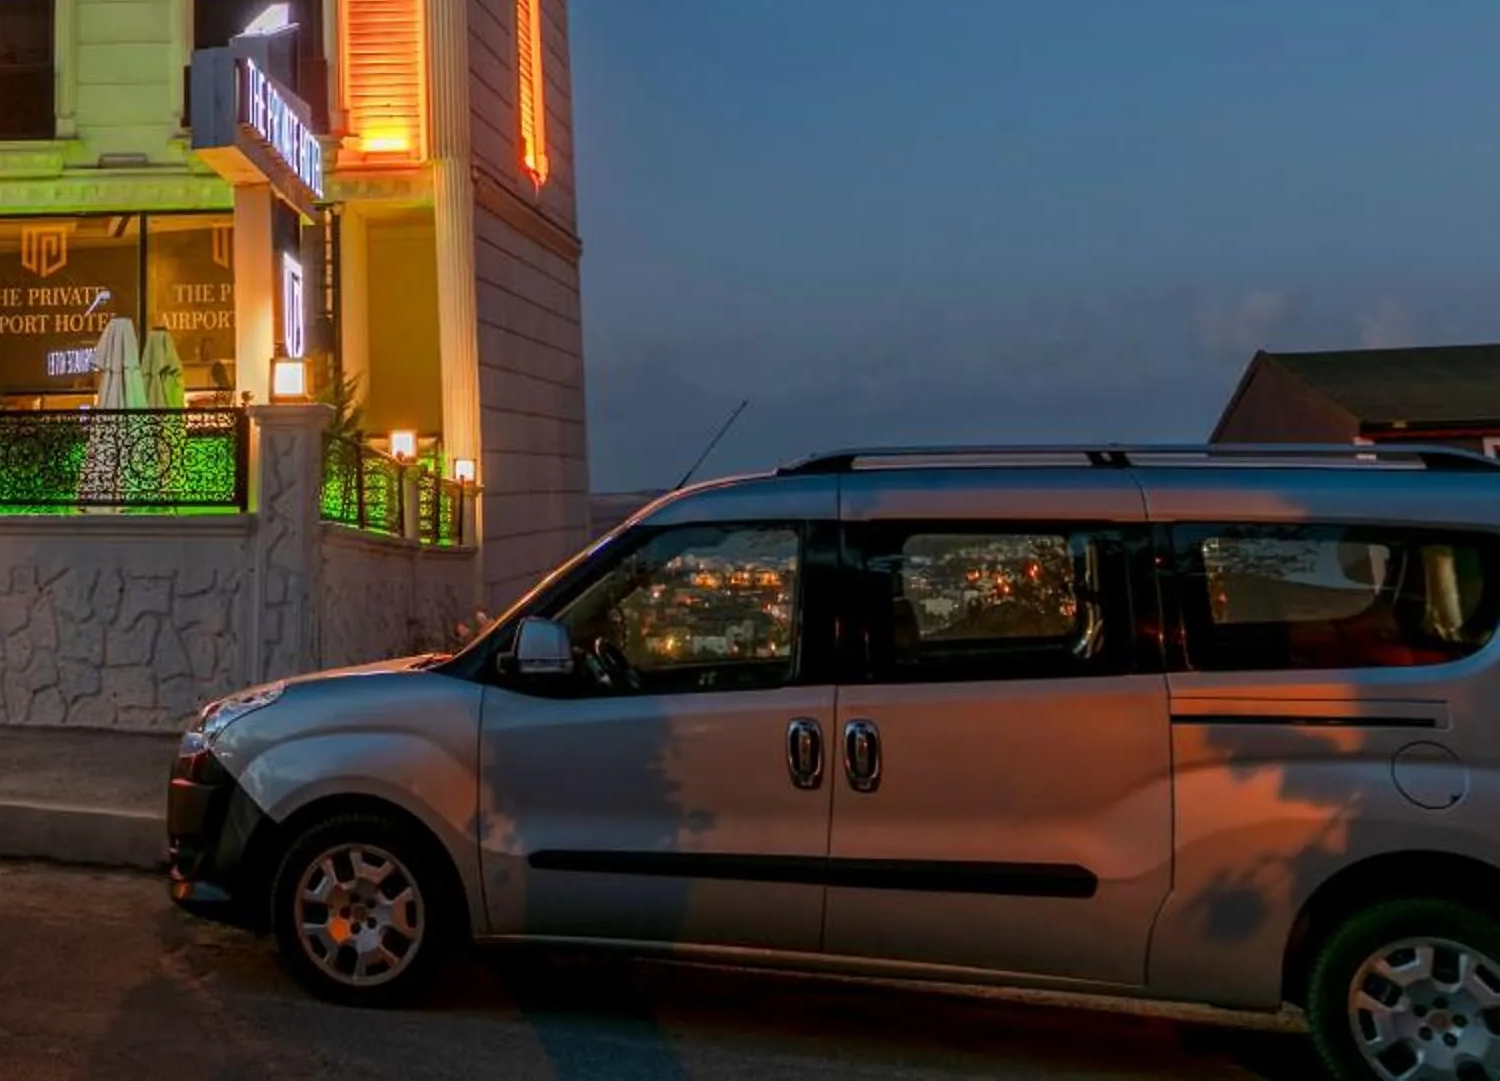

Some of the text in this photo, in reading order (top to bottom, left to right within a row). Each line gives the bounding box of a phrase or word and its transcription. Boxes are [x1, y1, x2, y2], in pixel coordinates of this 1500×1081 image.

[246, 56, 267, 139] THE
[173, 283, 216, 303] THE
[55, 312, 116, 333] HOTE
